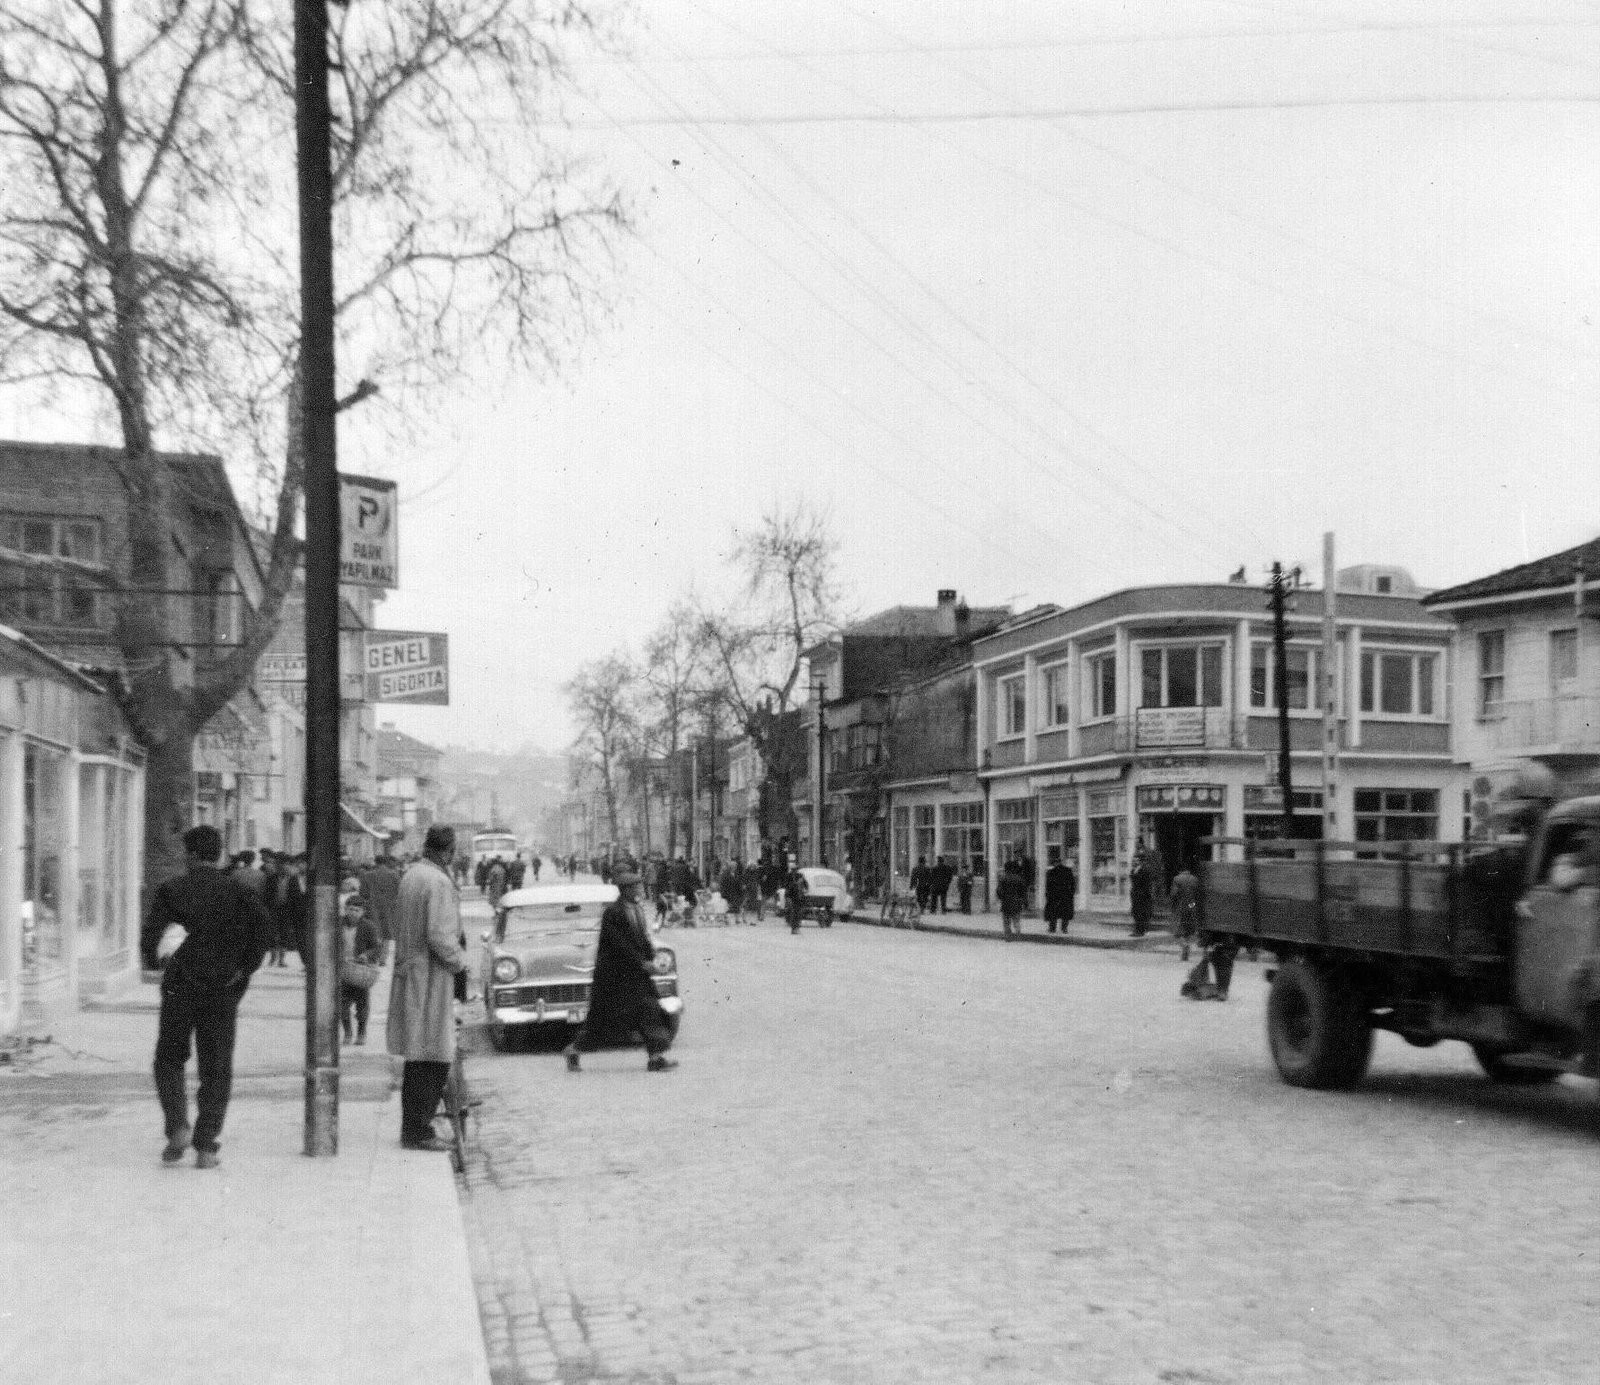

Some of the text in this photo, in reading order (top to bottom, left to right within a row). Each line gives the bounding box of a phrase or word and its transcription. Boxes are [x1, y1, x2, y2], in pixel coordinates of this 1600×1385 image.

[359, 495, 379, 529] P
[353, 543, 382, 560] PARK
[368, 642, 428, 669] GENEL
